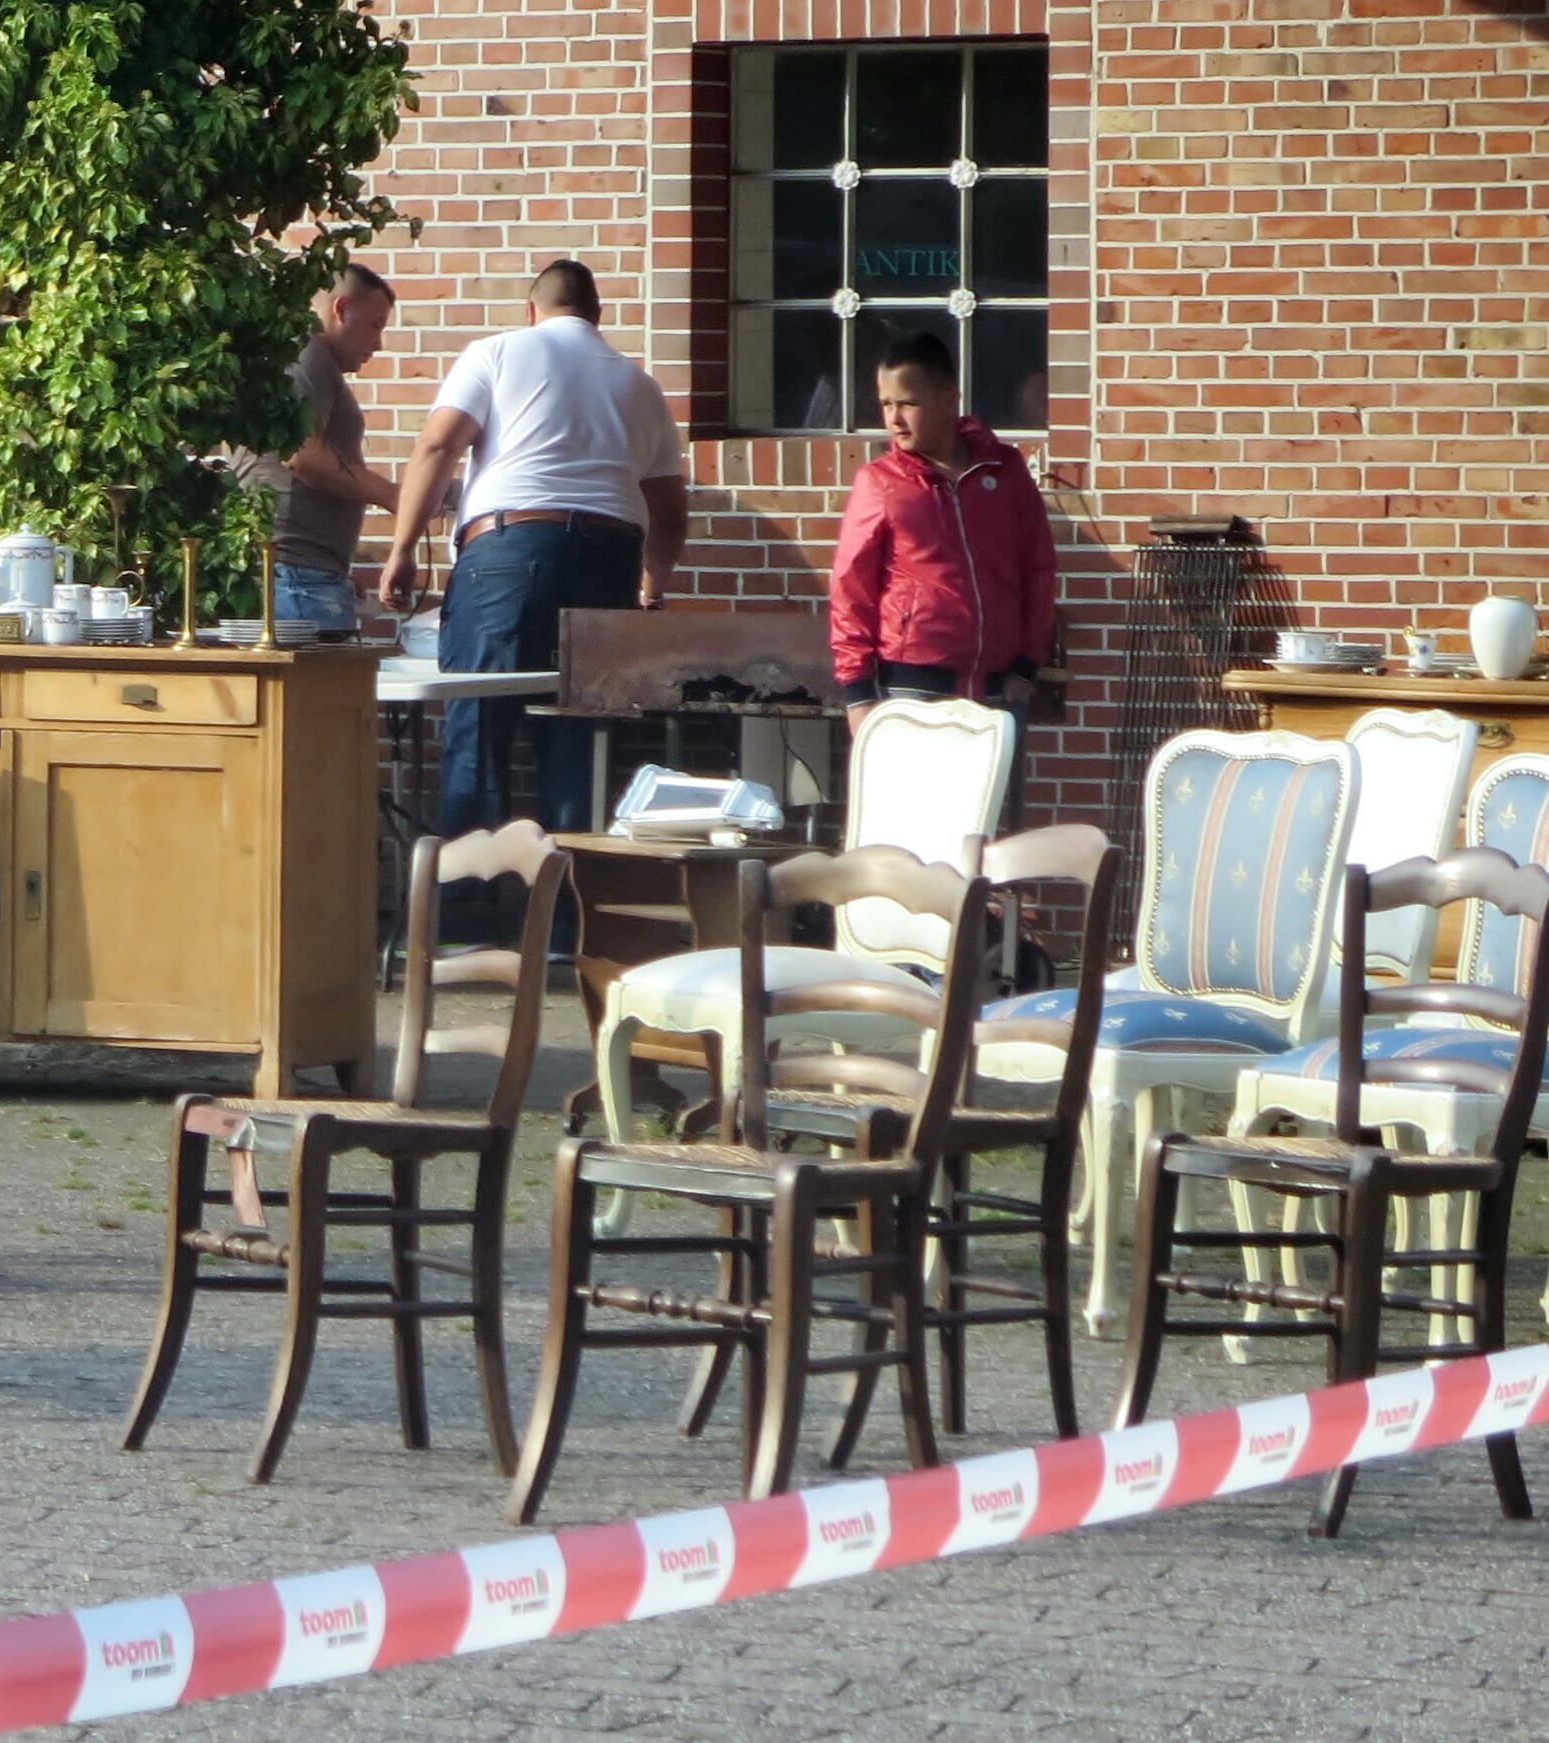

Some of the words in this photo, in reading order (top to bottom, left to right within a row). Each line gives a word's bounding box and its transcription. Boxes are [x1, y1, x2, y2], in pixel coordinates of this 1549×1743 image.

[856, 250, 962, 277] ANTIK
[971, 1487, 1013, 1514] toom
[819, 1516, 865, 1544] toom
[658, 1543, 707, 1573] toom
[485, 1575, 536, 1604] toom
[300, 1606, 355, 1637] toom
[102, 1635, 160, 1669] toom
